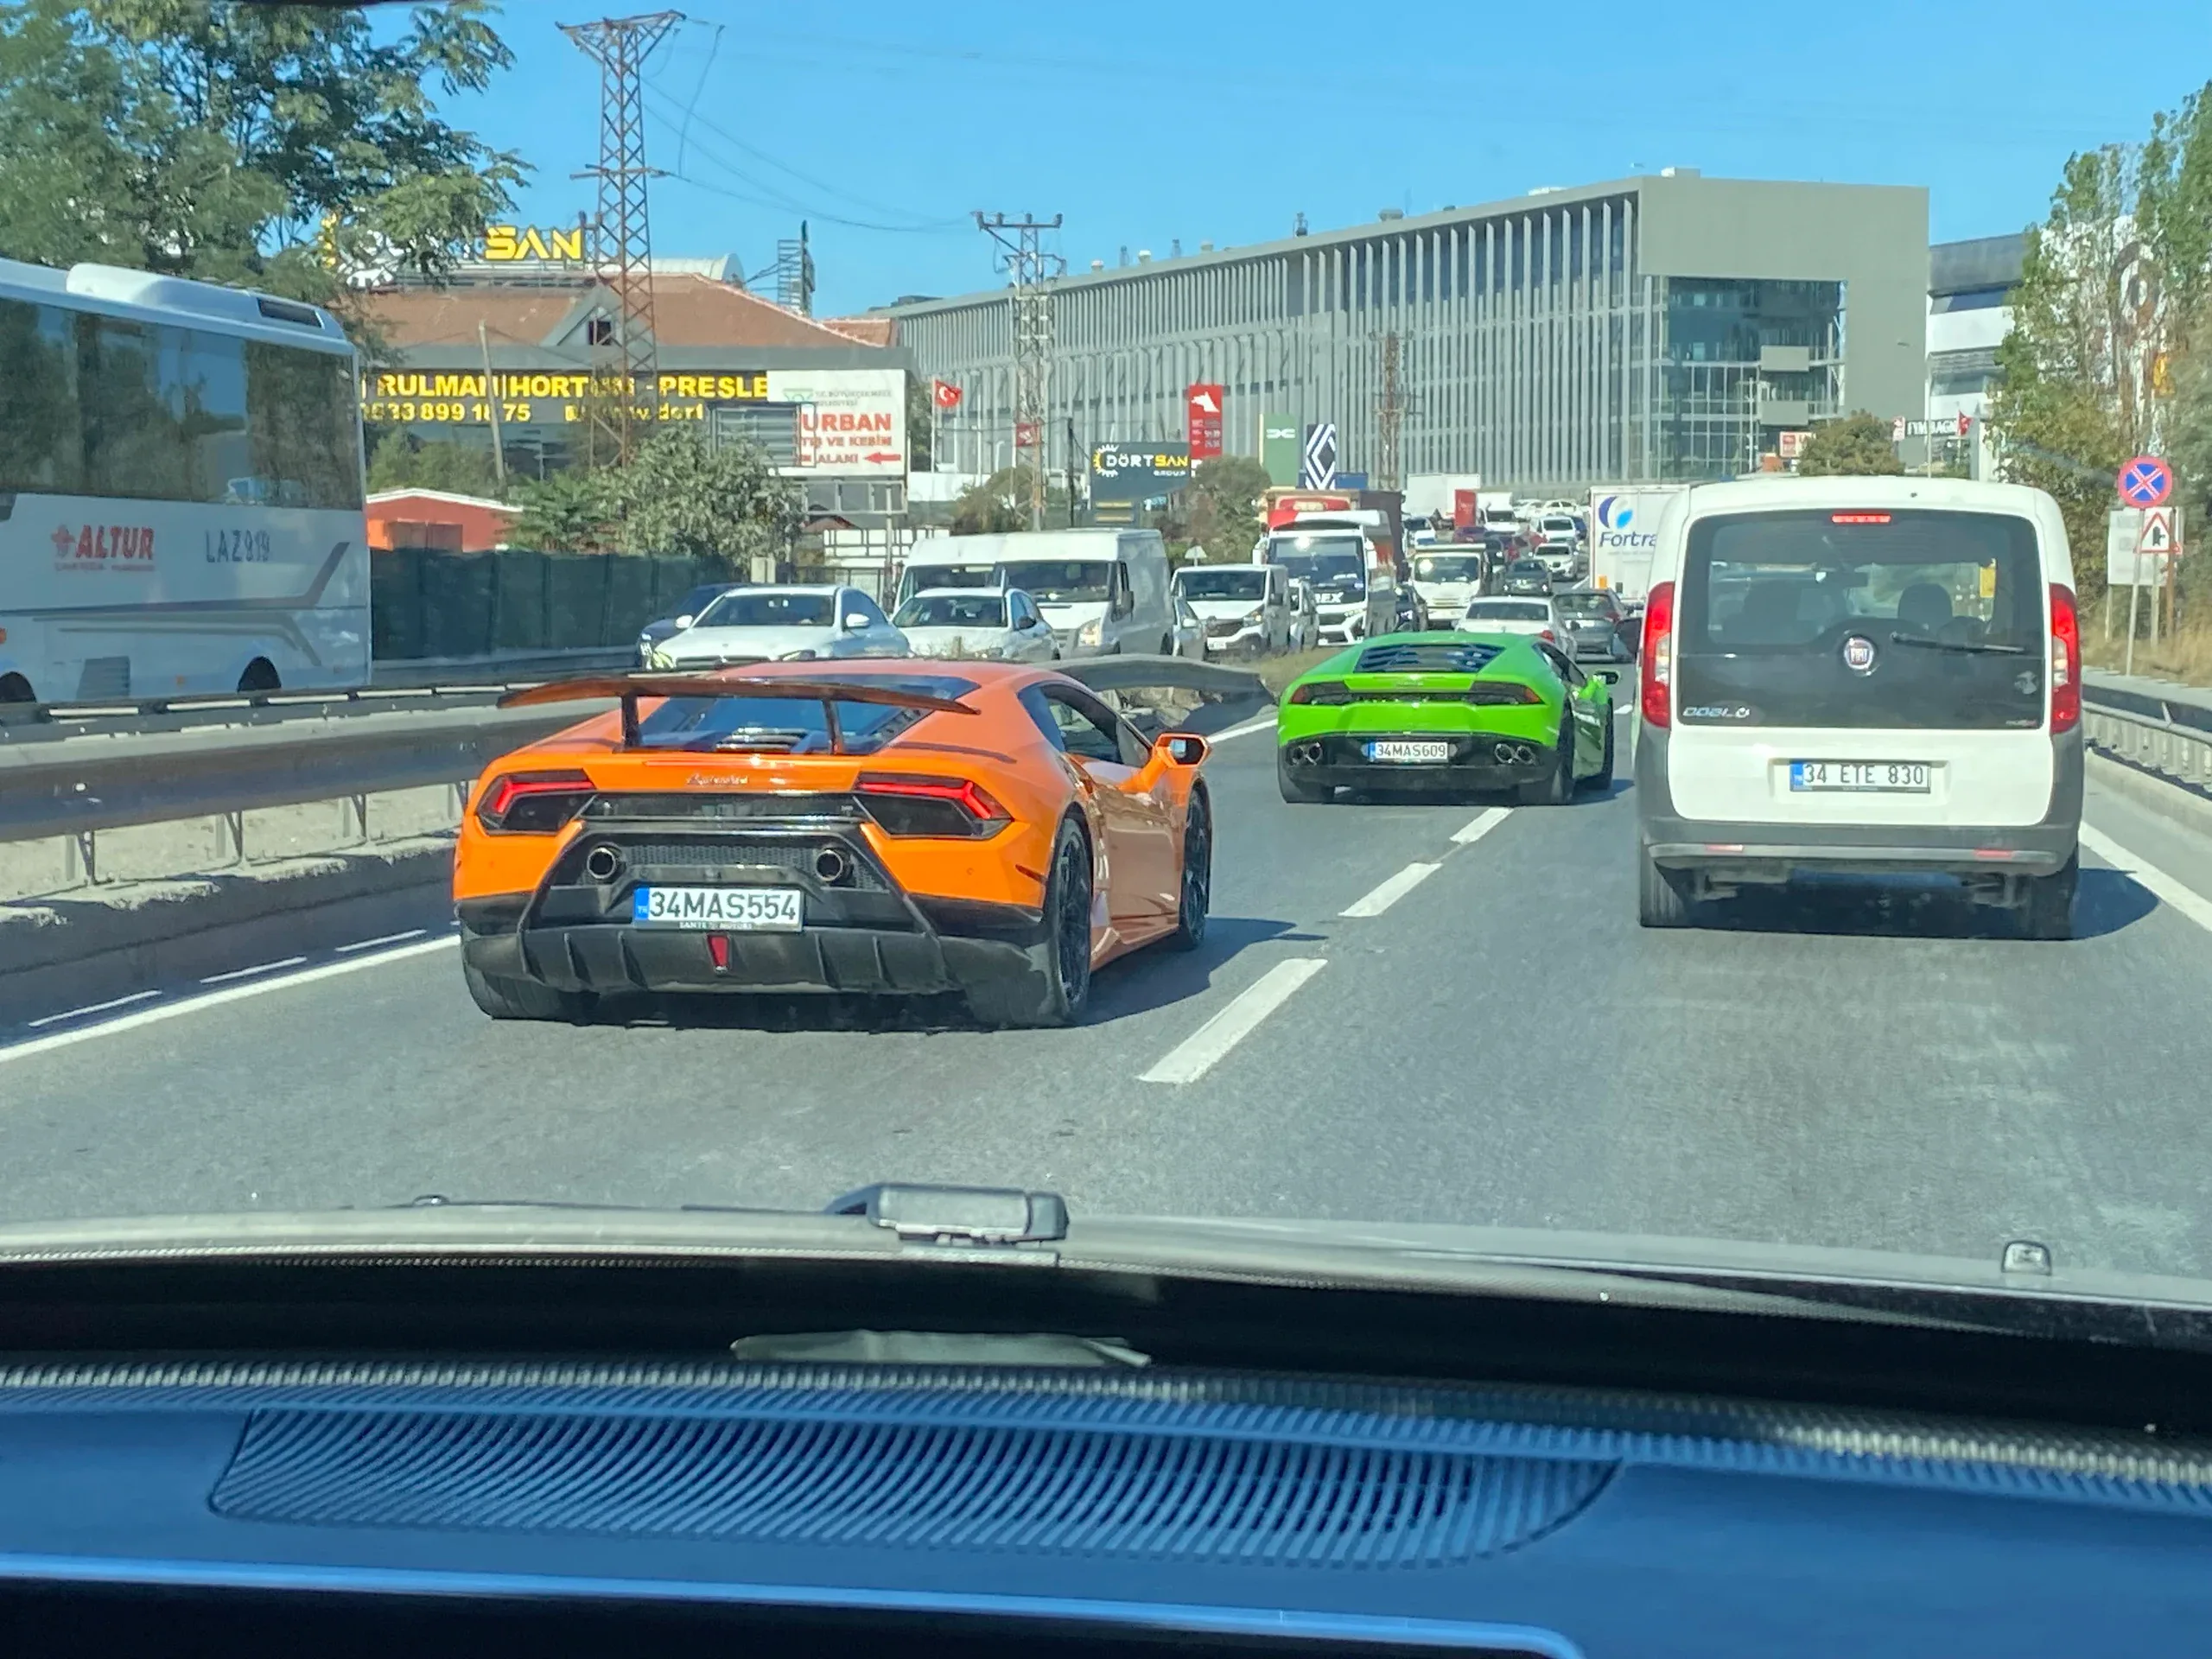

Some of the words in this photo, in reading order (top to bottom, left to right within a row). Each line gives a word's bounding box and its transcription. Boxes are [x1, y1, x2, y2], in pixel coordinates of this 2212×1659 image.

[420, 403, 465, 422] 899
[503, 403, 531, 422] 75
[827, 436, 844, 446] VE
[1106, 454, 1188, 467] DÖRTSAN
[75, 524, 155, 561] ALTUR
[1803, 764, 1827, 784] 34
[1840, 764, 1876, 784] ETE
[1887, 765, 1923, 785] 830
[650, 891, 797, 920] 34MAS554
